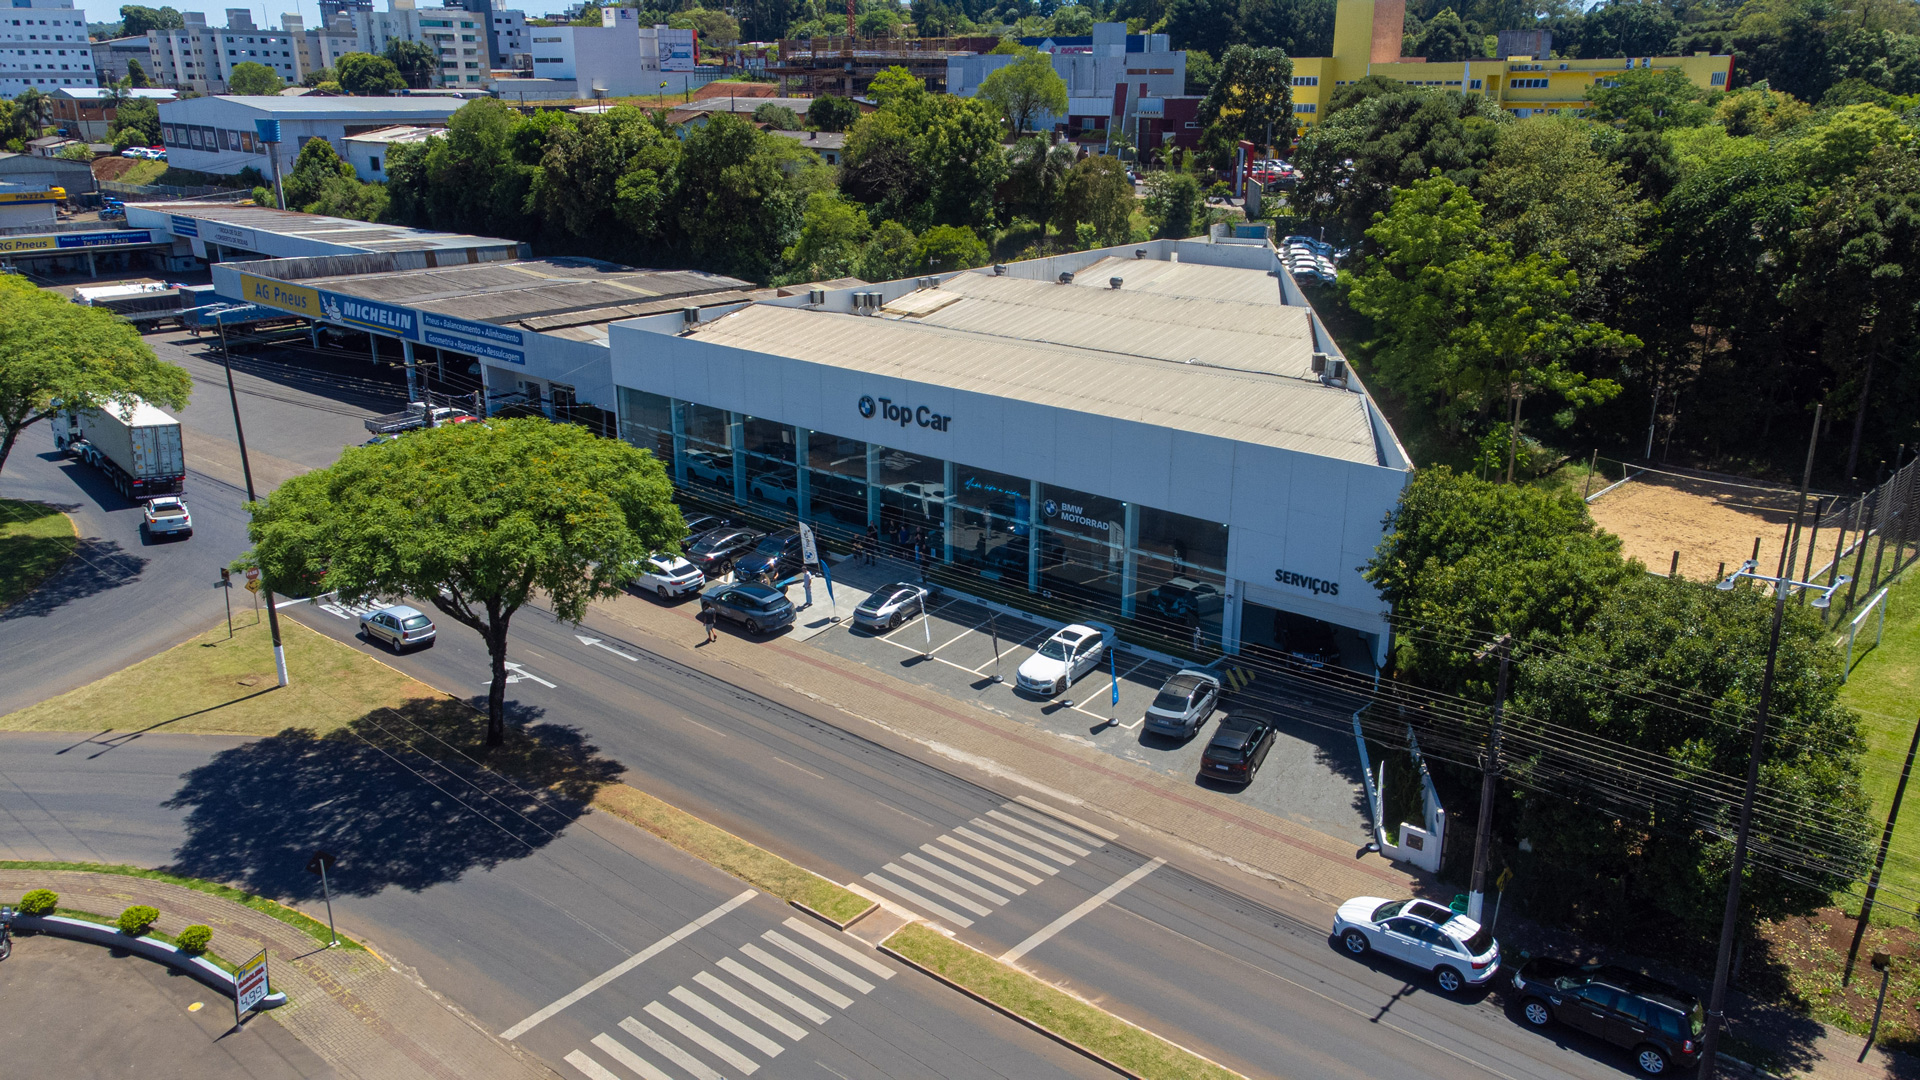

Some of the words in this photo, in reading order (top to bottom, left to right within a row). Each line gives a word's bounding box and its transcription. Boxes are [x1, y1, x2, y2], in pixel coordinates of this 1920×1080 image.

[16, 241, 47, 249] Pneus
[255, 282, 270, 300] AG
[274, 286, 307, 309] Pneus
[343, 301, 412, 330] MICHELIN
[425, 315, 440, 326] Pneus
[443, 319, 482, 335] Balanceamento
[484, 328, 520, 344] Alinhamento
[428, 333, 454, 347] Geometria
[457, 340, 483, 354] Reparação
[486, 347, 520, 362] Ressulcagem
[878, 397, 913, 428] Top
[916, 405, 952, 433] Car
[1060, 512, 1110, 531] MOTORRAD
[1061, 502, 1083, 515] BMW
[1274, 568, 1339, 596] SERVIÇOS
